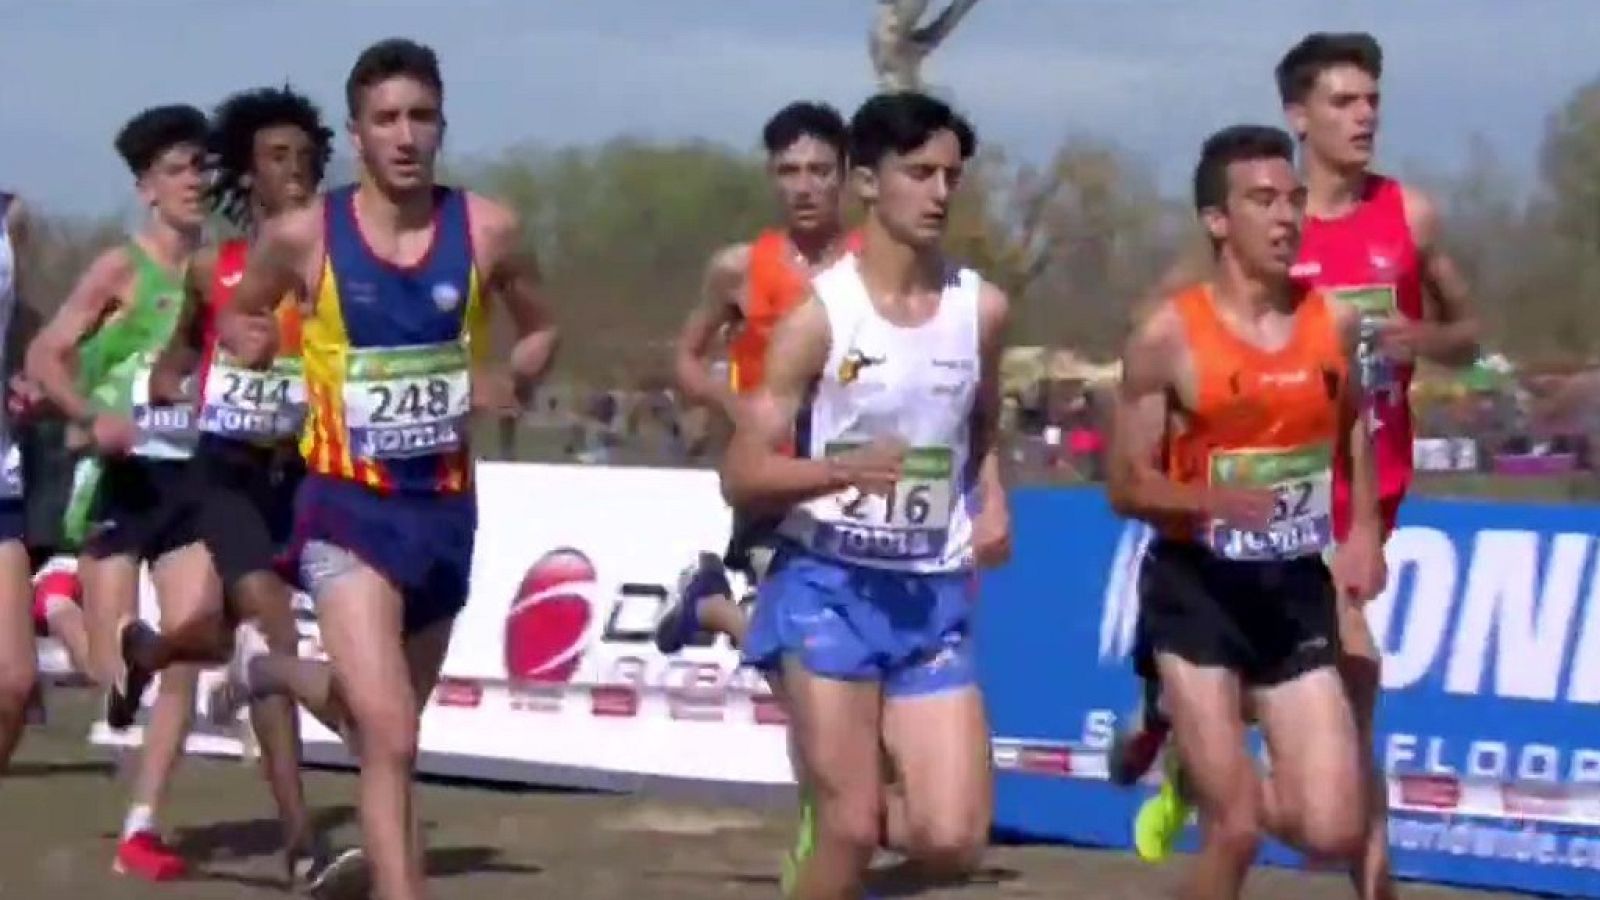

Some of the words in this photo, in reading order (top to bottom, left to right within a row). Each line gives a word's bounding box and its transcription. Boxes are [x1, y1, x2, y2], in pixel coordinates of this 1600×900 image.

[223, 373, 290, 407] 244
[366, 378, 449, 422] 248
[836, 482, 931, 524] 216
